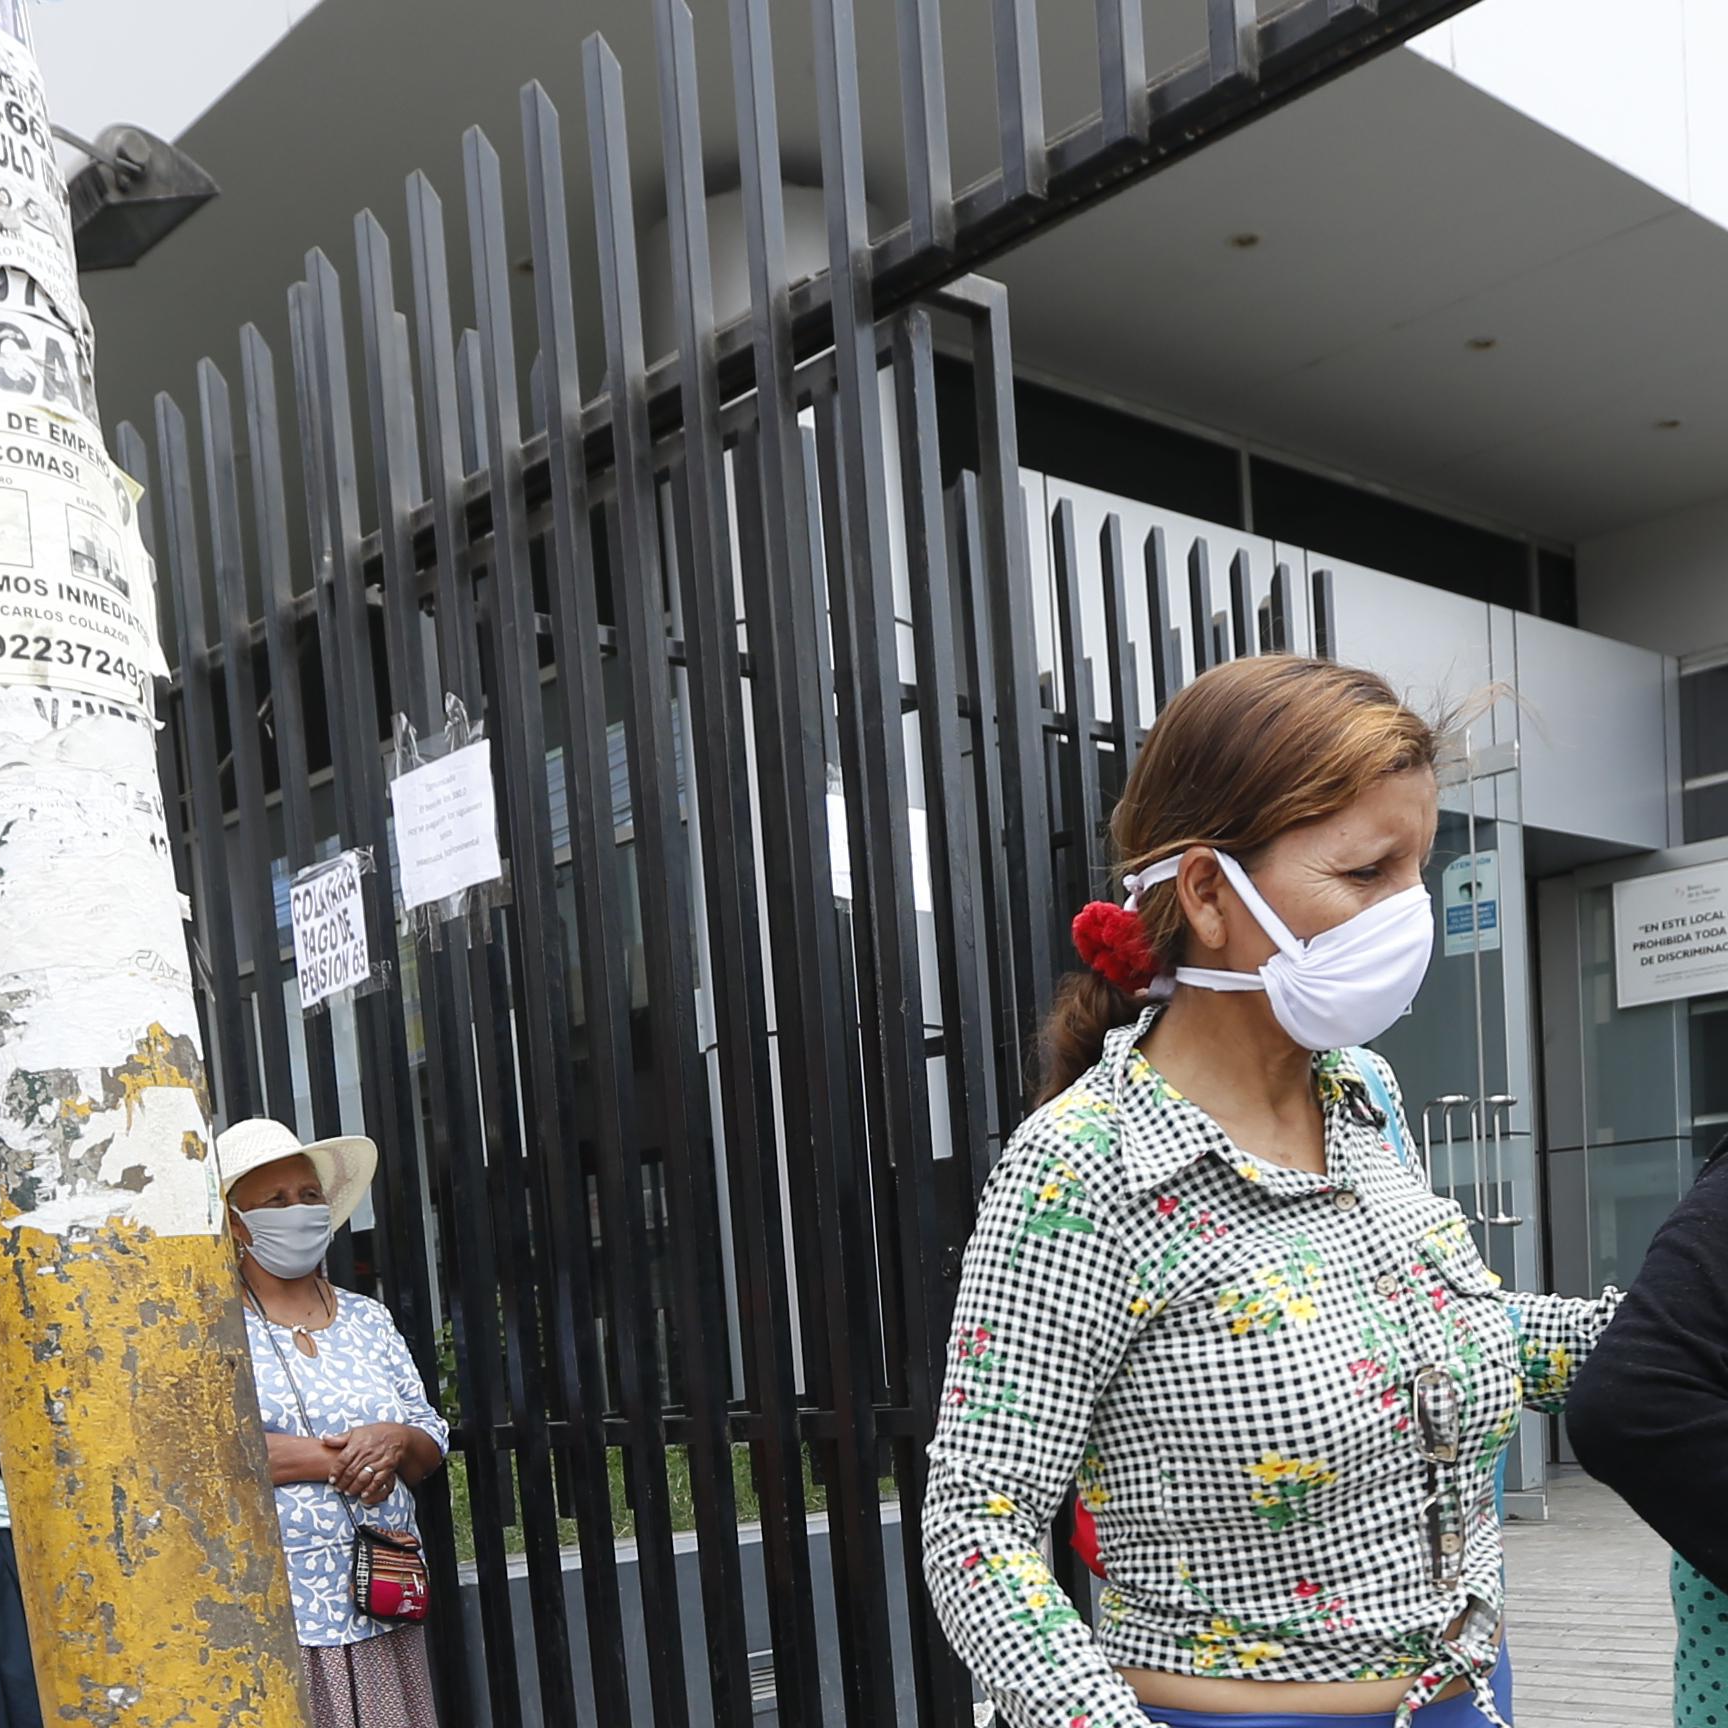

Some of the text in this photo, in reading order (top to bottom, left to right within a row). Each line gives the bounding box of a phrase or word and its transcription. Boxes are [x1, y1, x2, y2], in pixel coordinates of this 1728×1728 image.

[7, 411, 41, 436] DE
[0, 605, 64, 624] CARLOS
[1449, 856, 1491, 871] ATENIÓN
[292, 882, 327, 926] COLA
[1662, 916, 1687, 930] ESTE
[1690, 909, 1725, 925] LOCAL
[302, 906, 355, 963] PAGO DE
[1633, 932, 1693, 952] PROHIBIDA
[1695, 926, 1727, 941] TODA
[300, 938, 366, 1001] PENSION 65
[1640, 955, 1655, 967] DE
